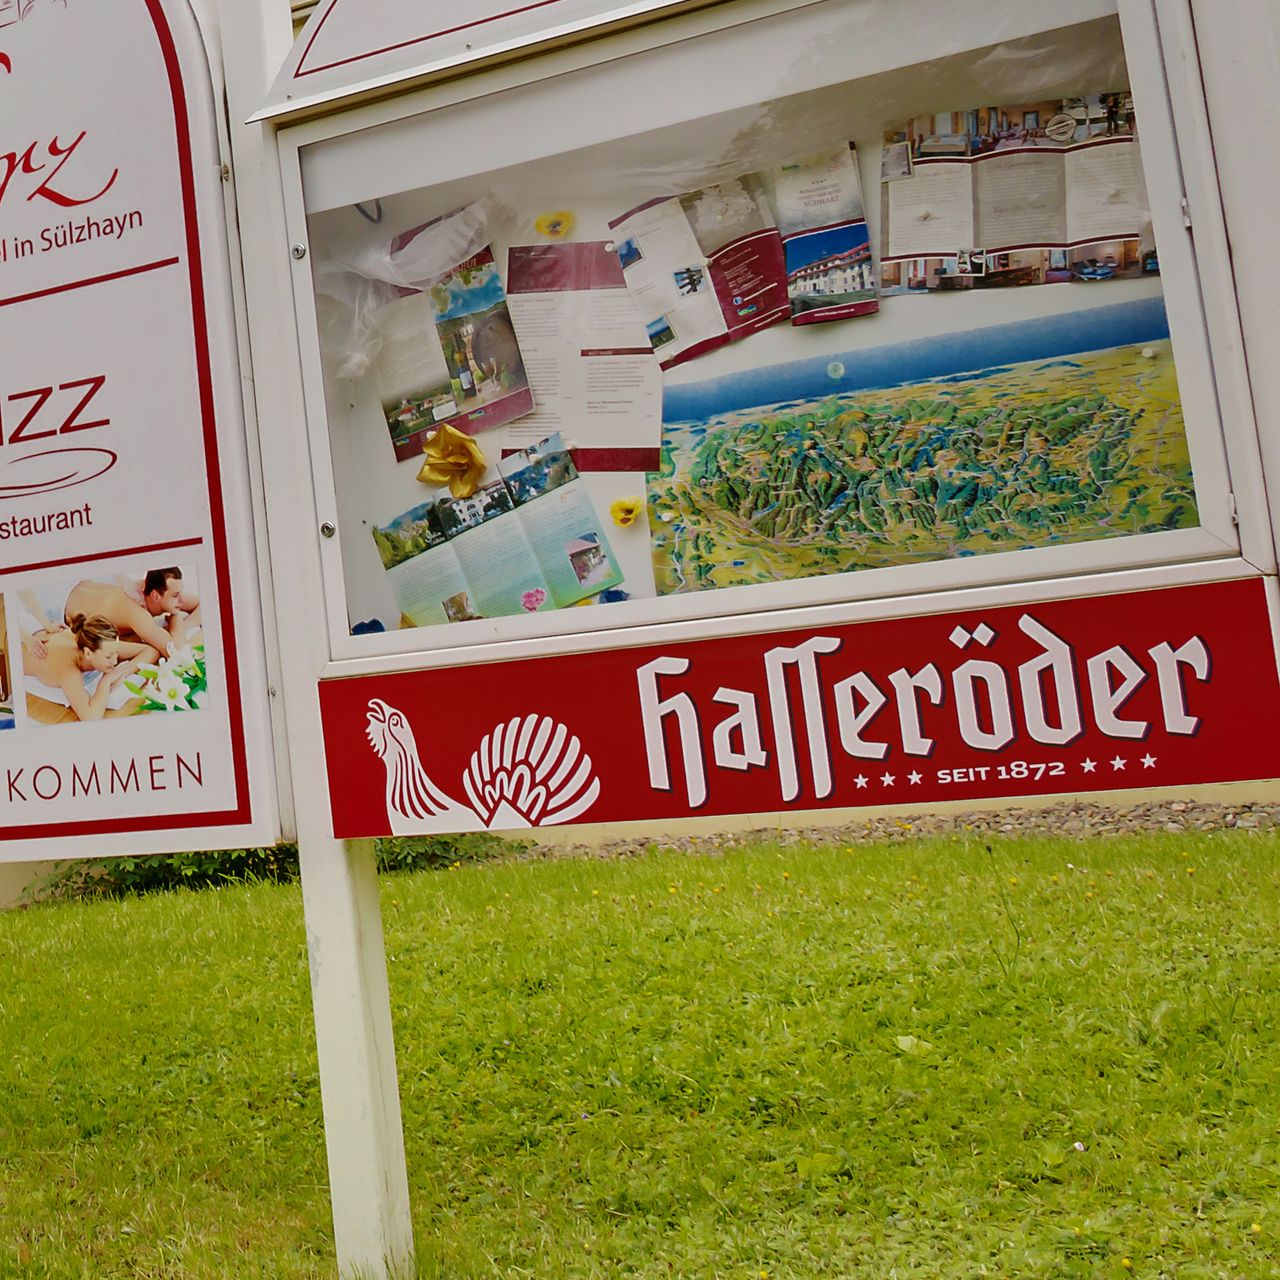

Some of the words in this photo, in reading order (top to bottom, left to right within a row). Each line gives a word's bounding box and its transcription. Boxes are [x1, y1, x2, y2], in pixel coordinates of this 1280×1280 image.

[14, 236, 34, 258] in
[40, 210, 144, 252] Sülzhayn
[937, 765, 991, 784] SEIT
[996, 759, 1066, 780] 1872
